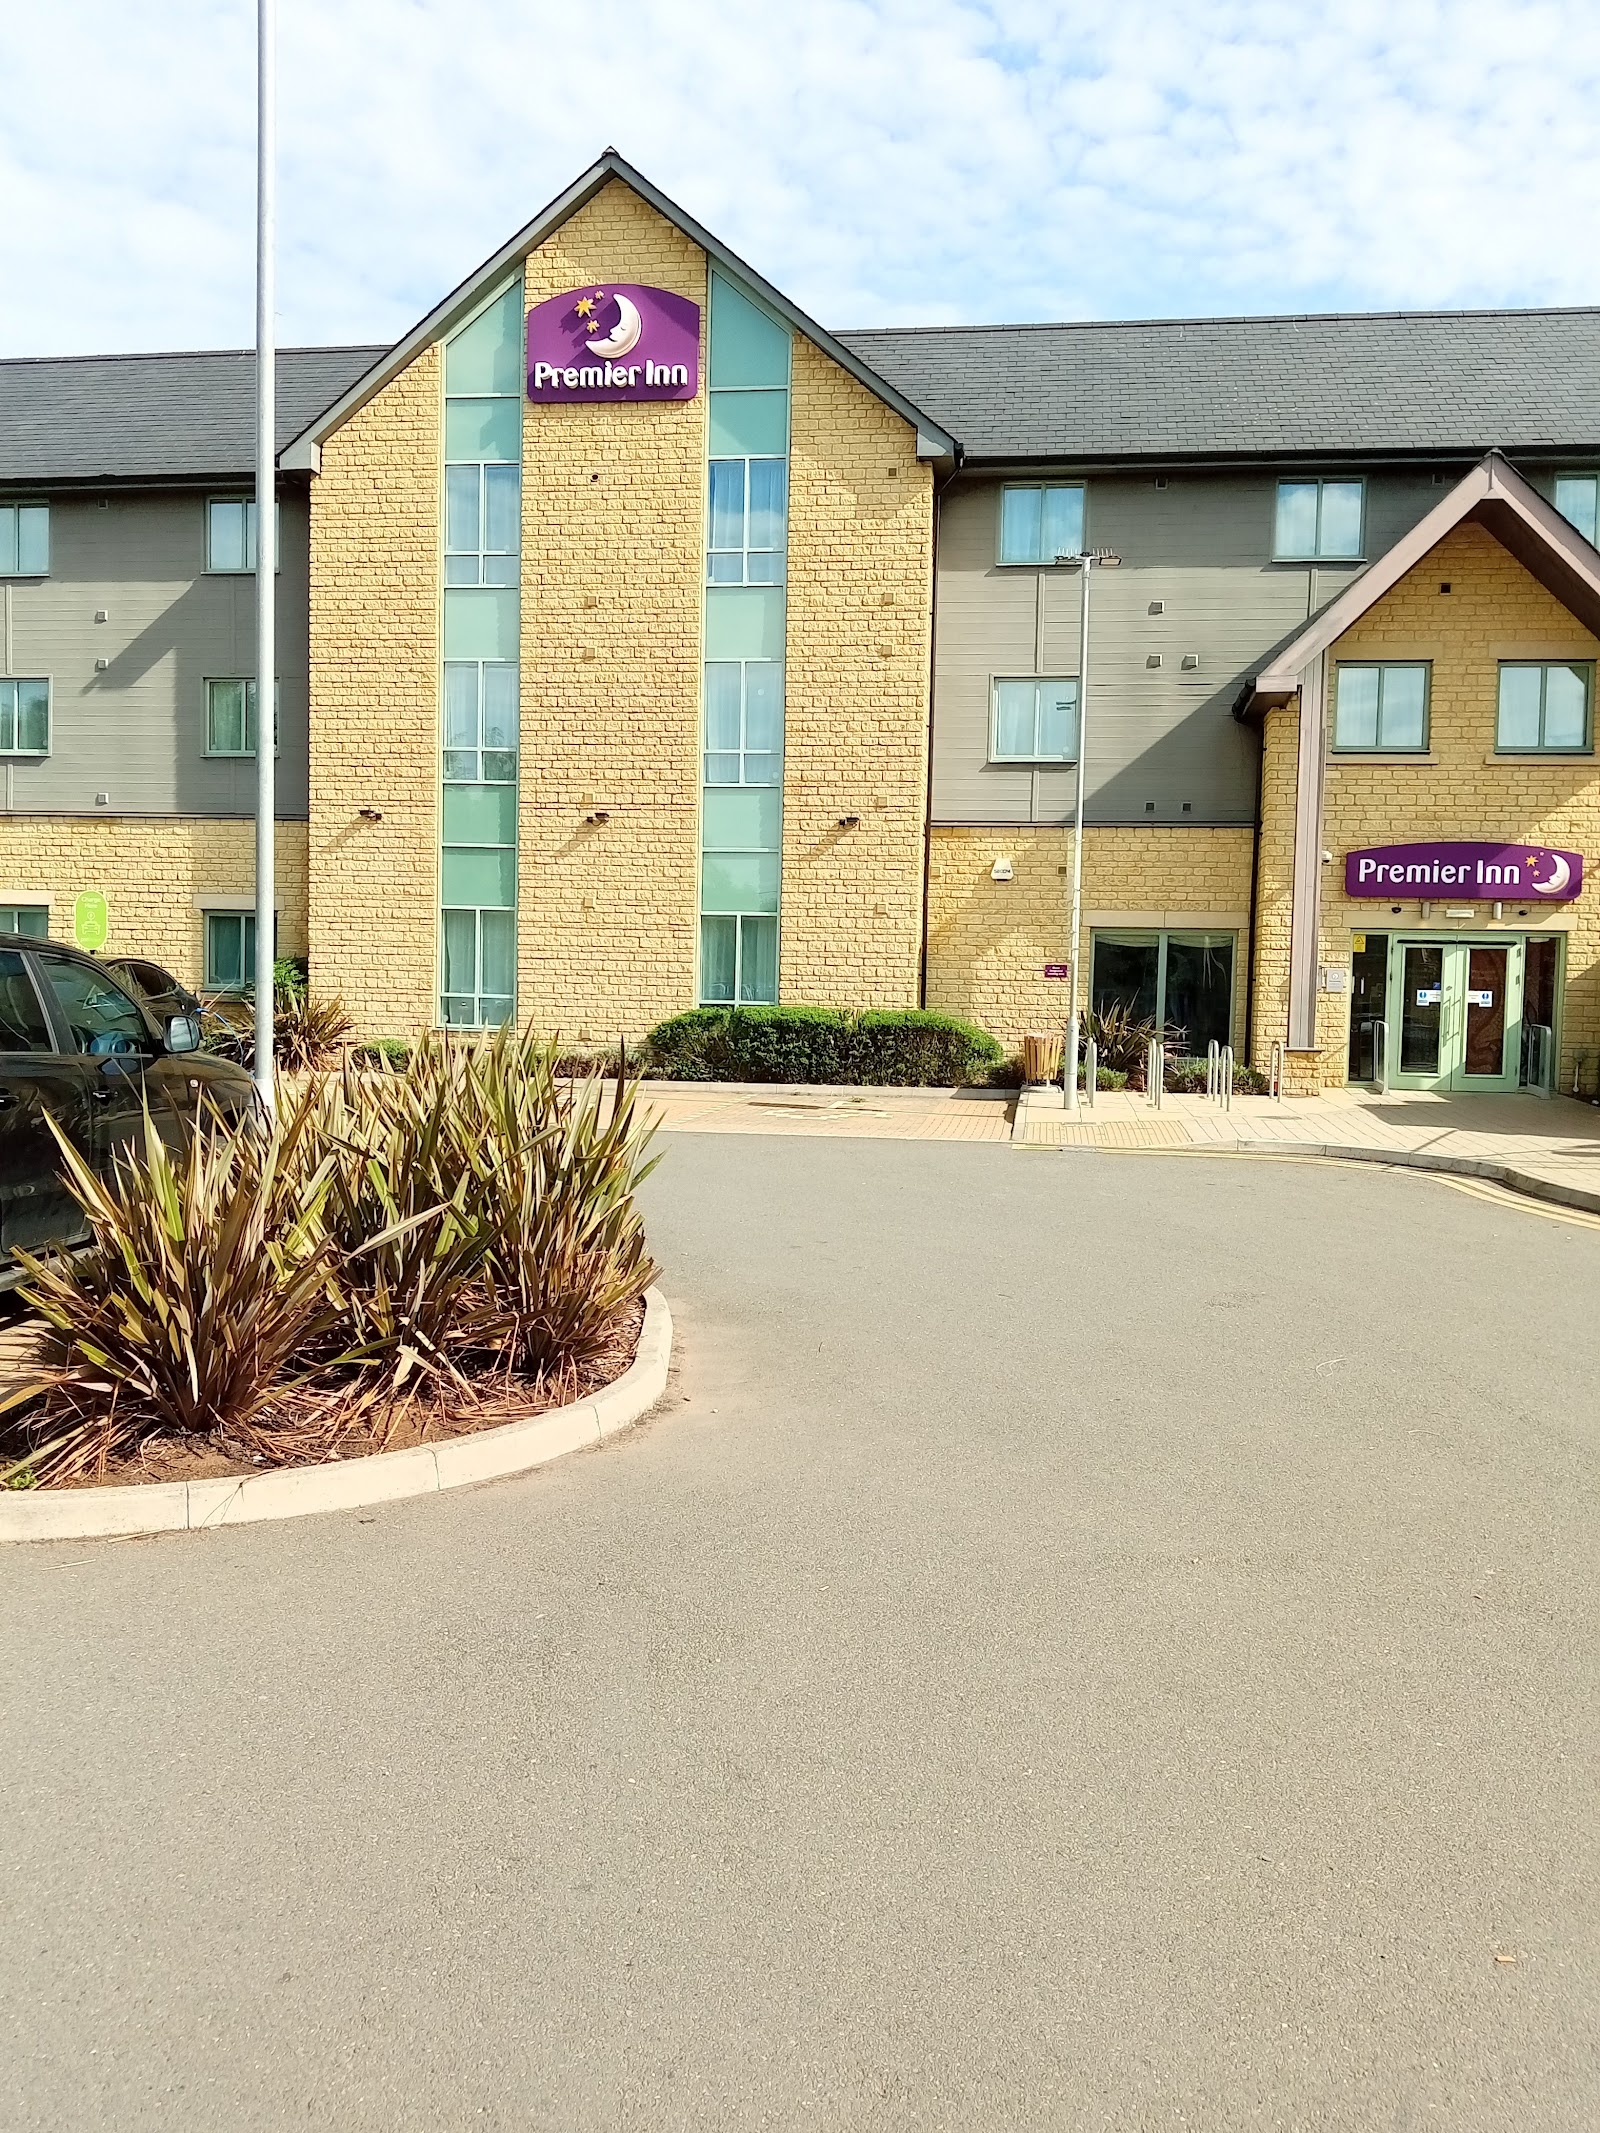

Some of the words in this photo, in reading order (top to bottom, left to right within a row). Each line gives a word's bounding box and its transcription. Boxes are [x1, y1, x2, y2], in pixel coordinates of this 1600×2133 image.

[534, 361, 642, 389] Premier
[645, 359, 688, 387] Inn
[1358, 858, 1471, 884] Premier
[1476, 860, 1521, 885] Inn
